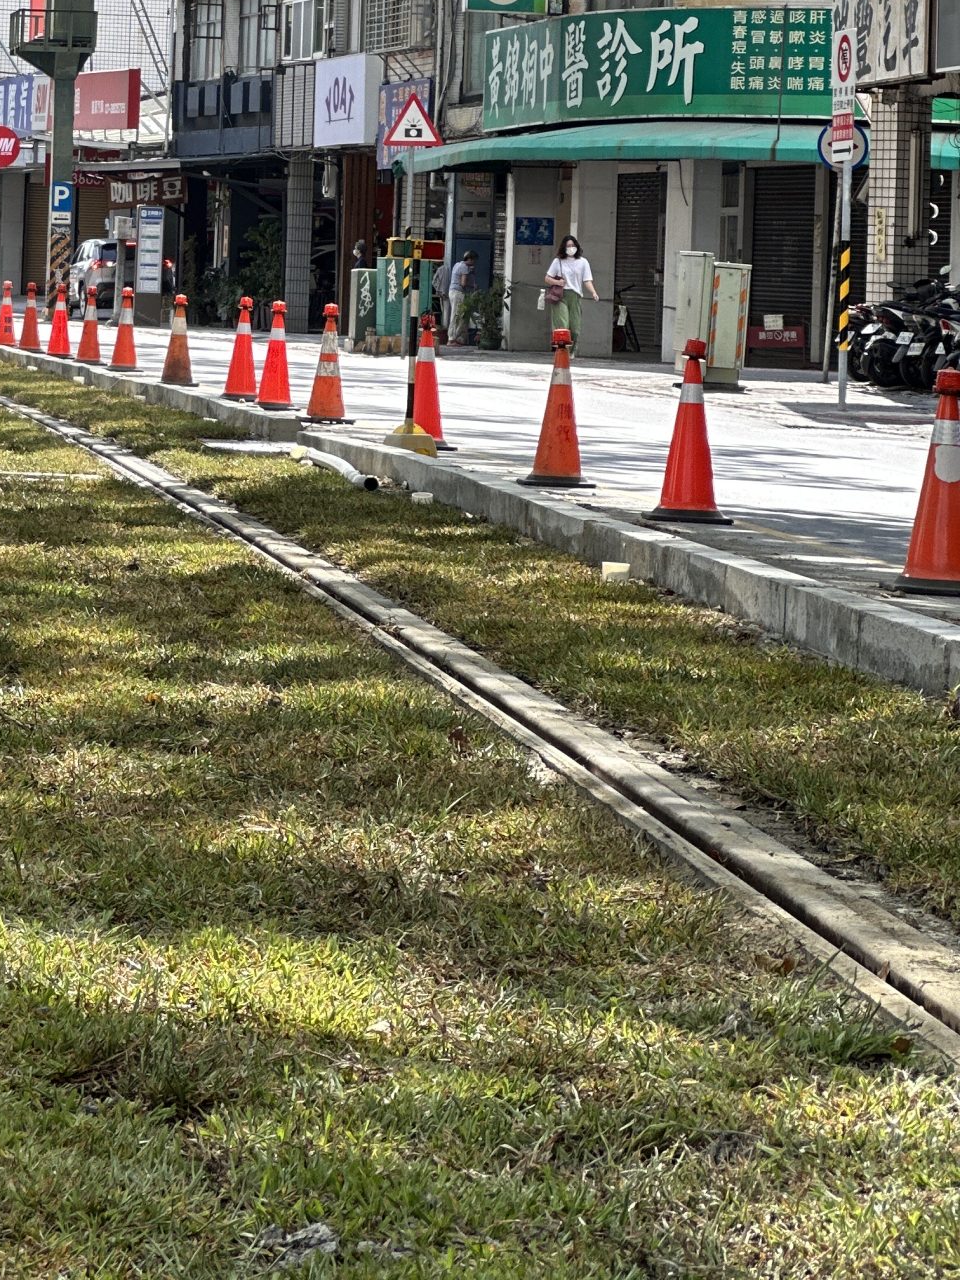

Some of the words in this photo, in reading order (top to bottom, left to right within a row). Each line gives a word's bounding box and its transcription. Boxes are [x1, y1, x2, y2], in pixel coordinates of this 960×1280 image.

[489, 17, 704, 119] 黃錦桐中醫診所
[54, 185, 70, 206] P
[110, 176, 183, 204] 咖啡豆
